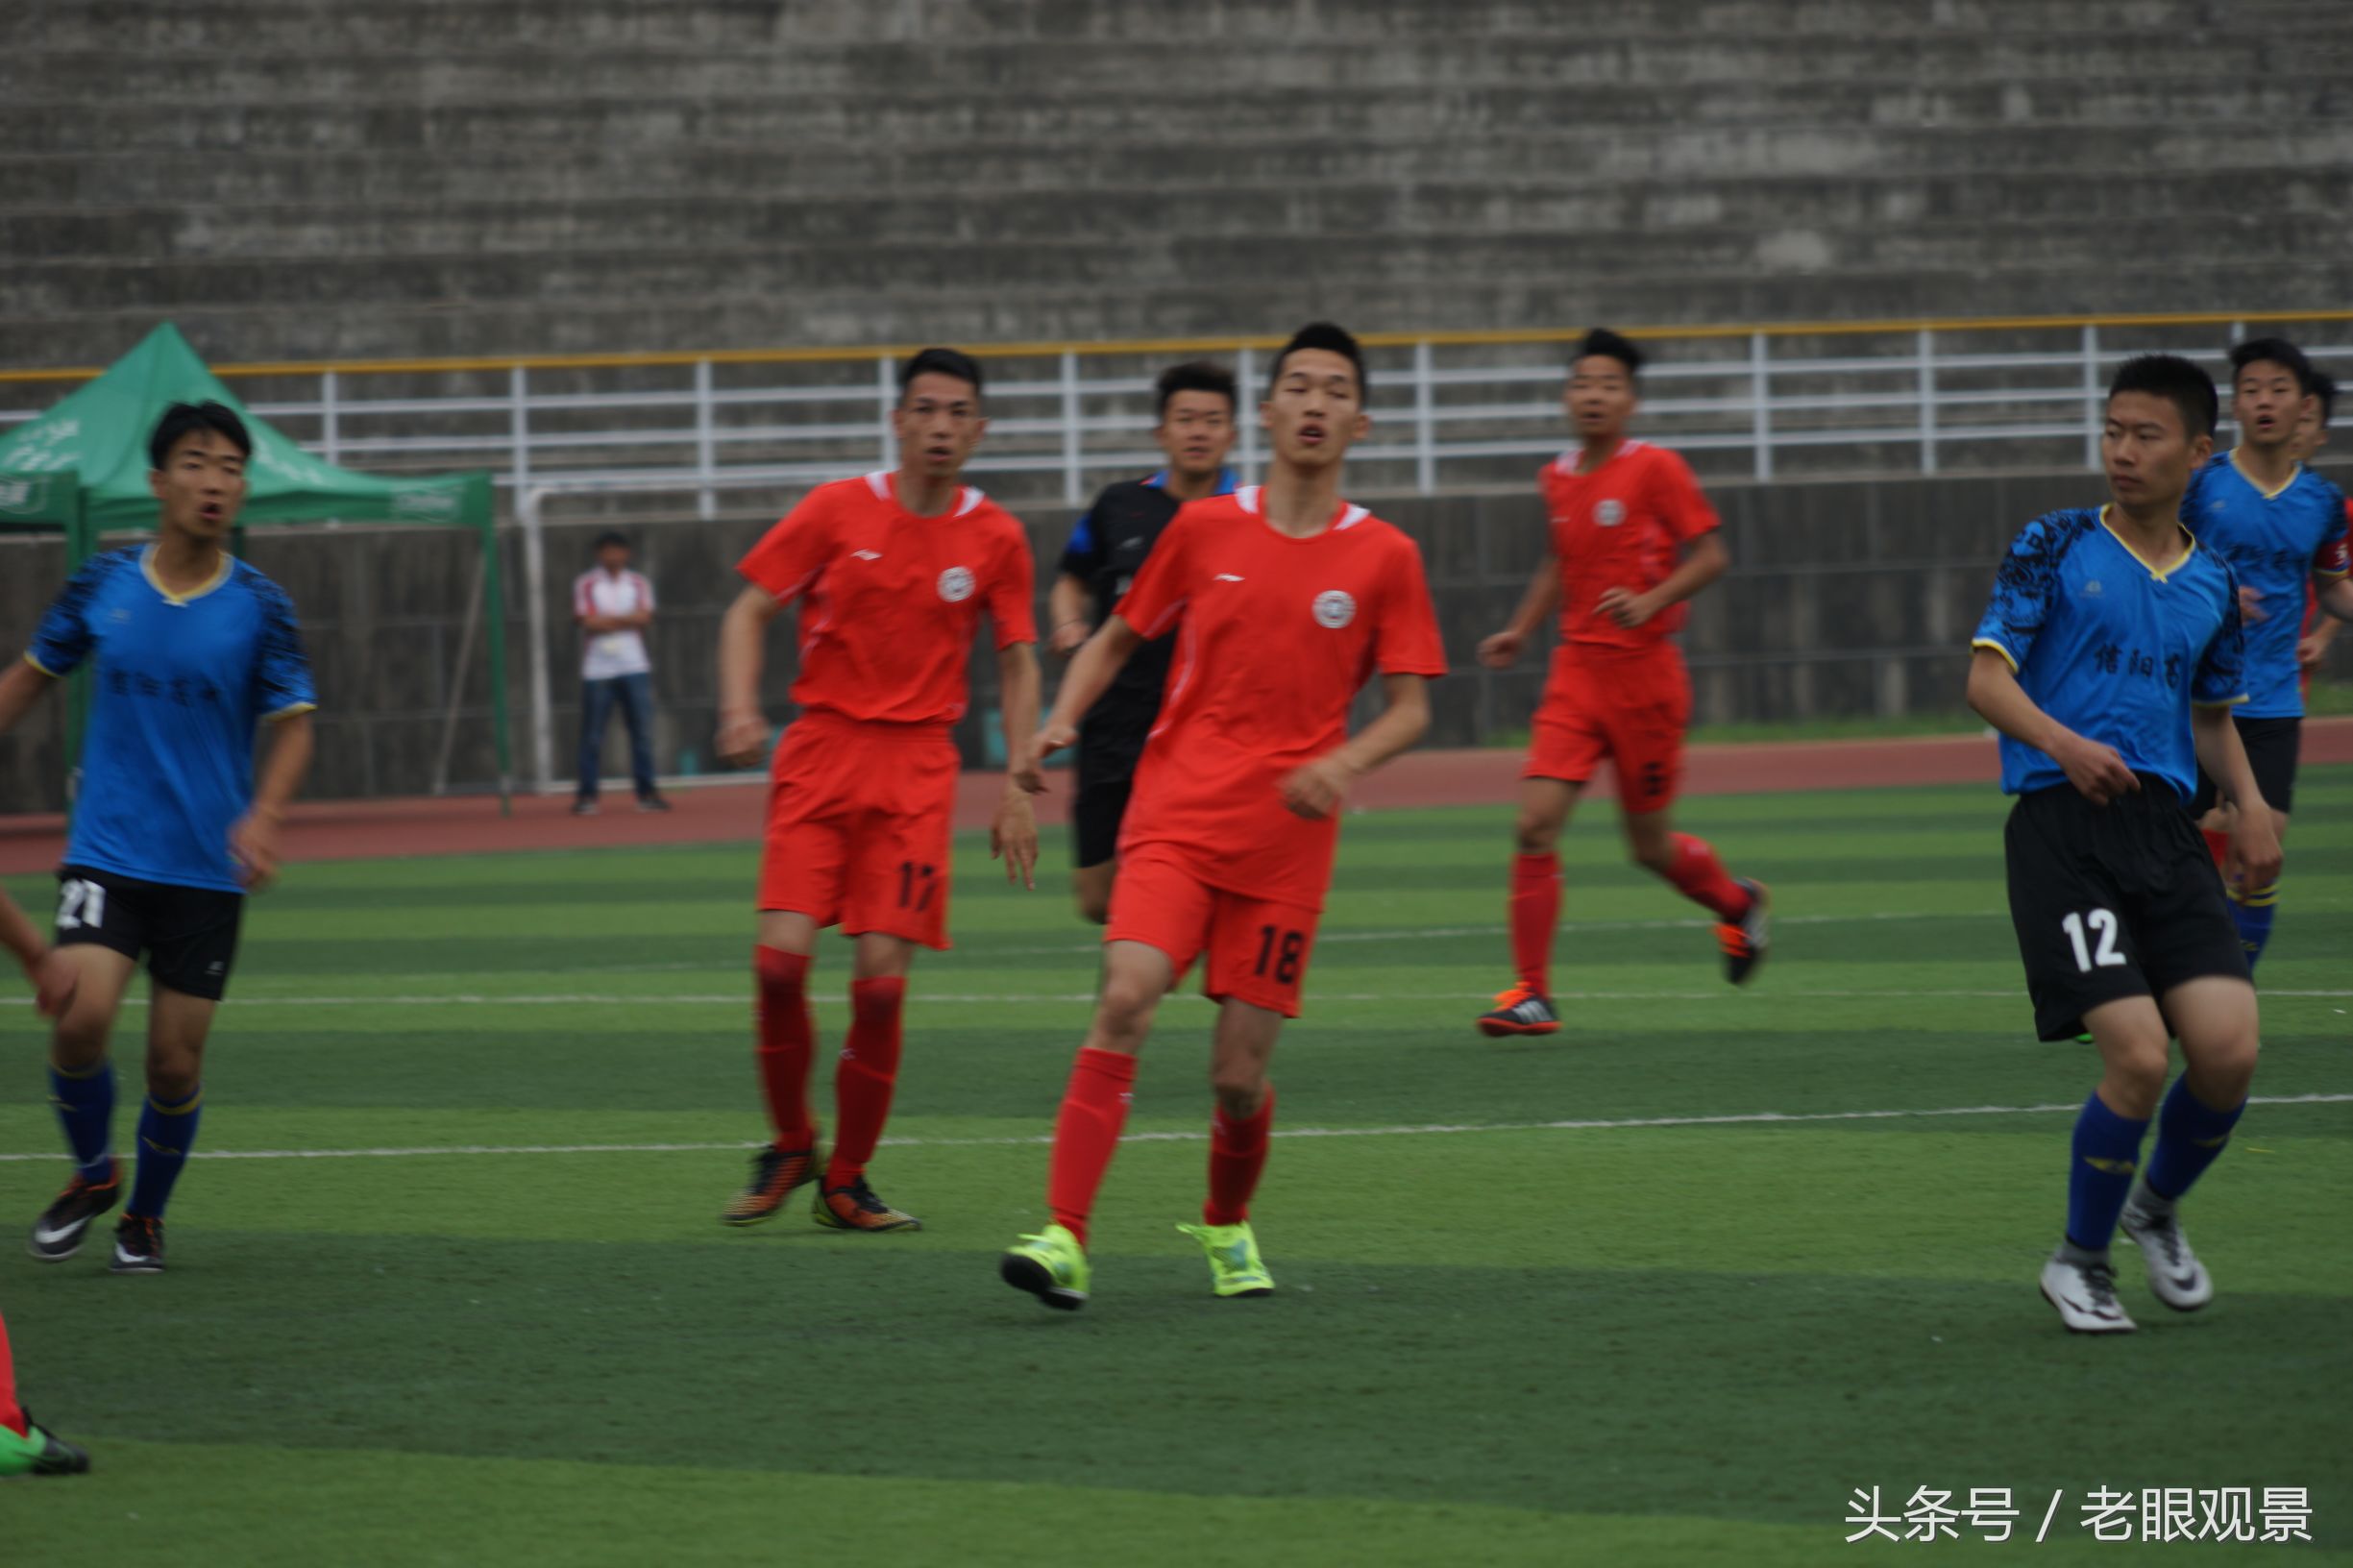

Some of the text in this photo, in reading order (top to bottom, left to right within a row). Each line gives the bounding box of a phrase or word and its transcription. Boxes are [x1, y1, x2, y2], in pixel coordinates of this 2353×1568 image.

[57, 878, 106, 929] 21
[899, 860, 938, 912] 17
[1253, 925, 1305, 985] 18
[2062, 908, 2127, 972] 12
